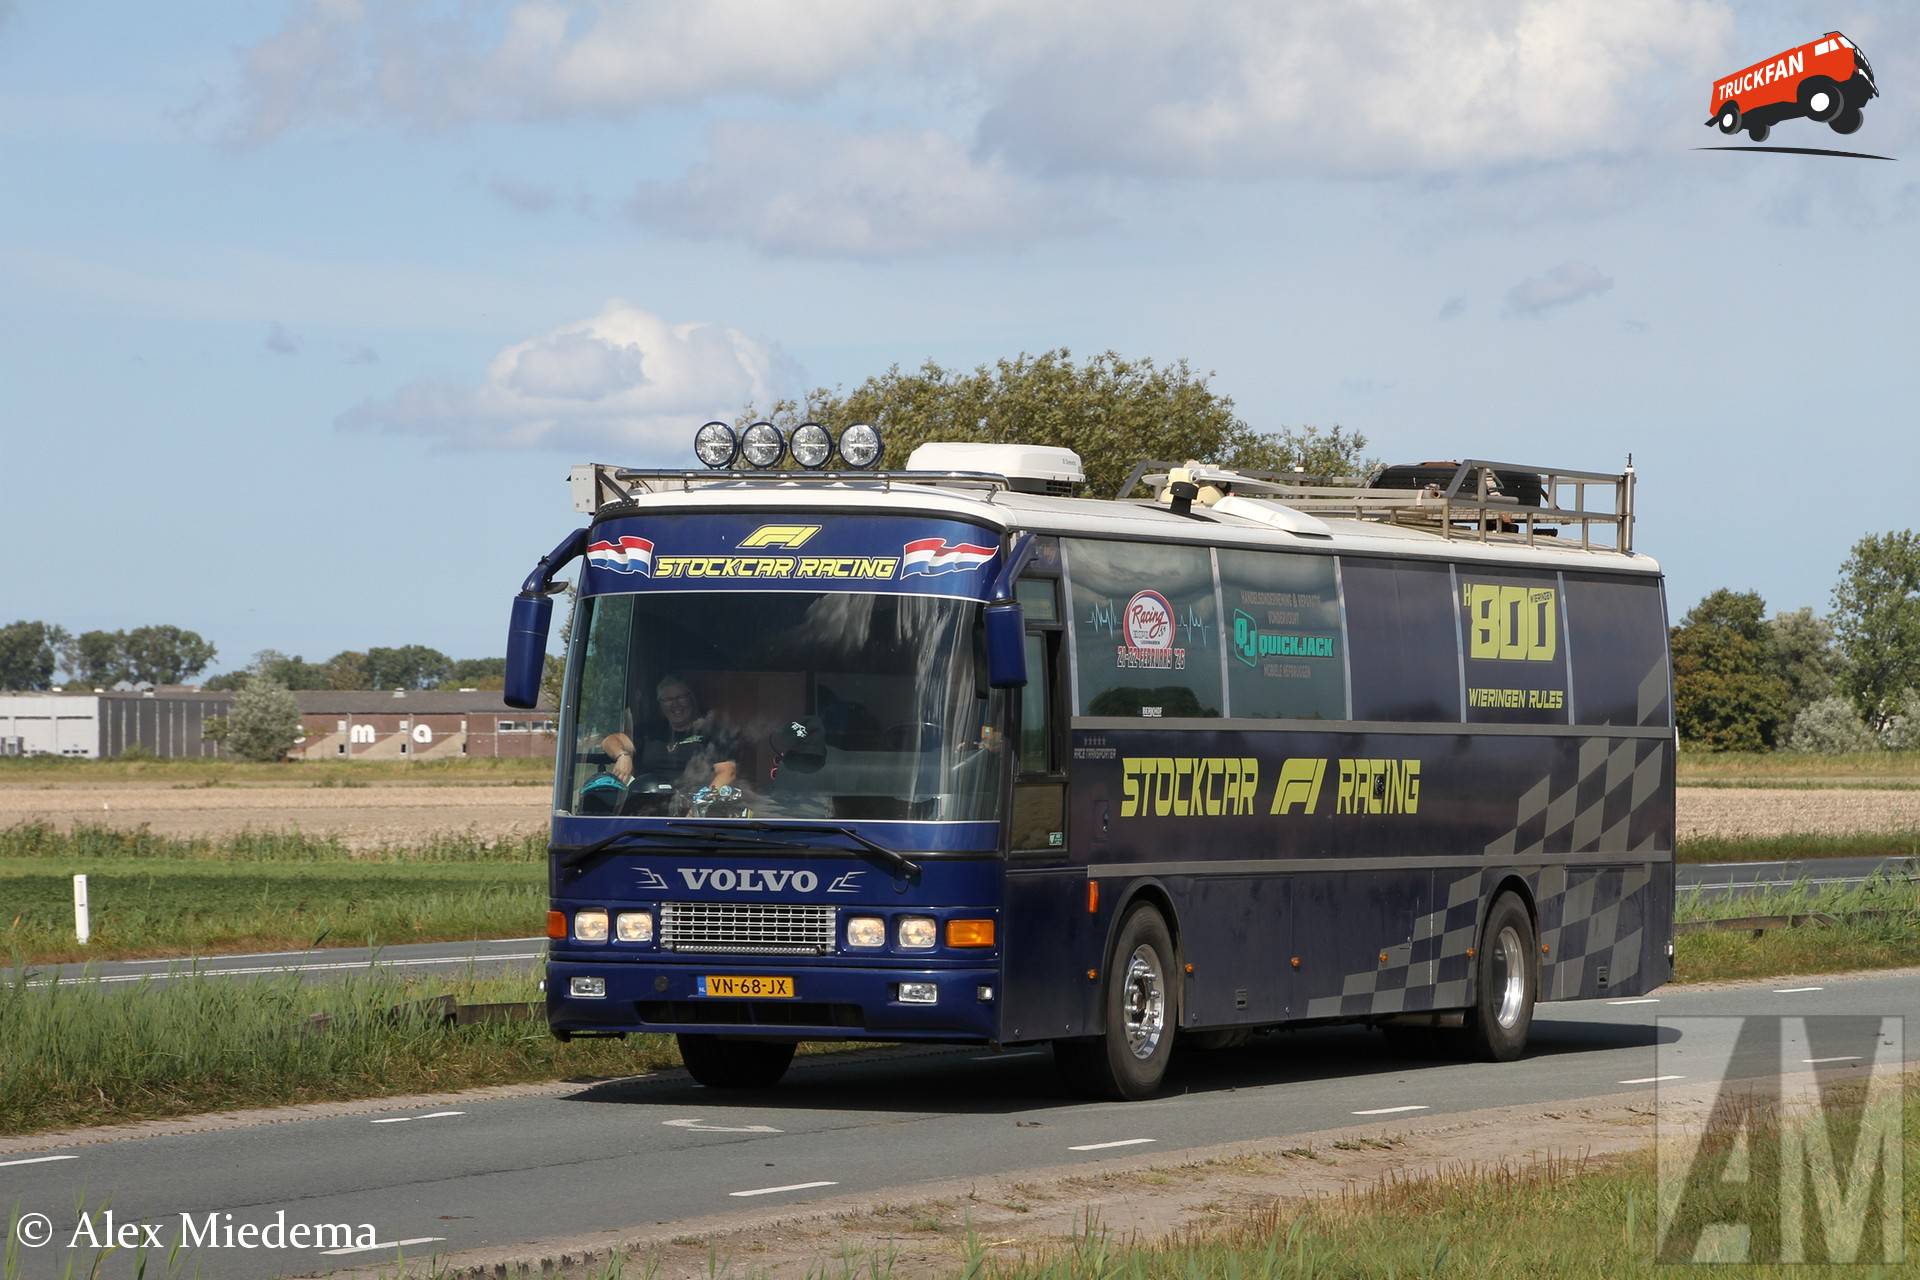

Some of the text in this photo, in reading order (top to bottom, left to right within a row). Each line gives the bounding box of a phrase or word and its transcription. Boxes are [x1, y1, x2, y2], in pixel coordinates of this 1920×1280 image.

[654, 557, 898, 578] STOCKCAR RACING
[1259, 635, 1333, 656] QUICKJACK
[1469, 688, 1563, 709] WIERINGEN RULES
[1120, 757, 1259, 817] STOCKCAR
[1336, 758, 1421, 814] RACING
[677, 868, 818, 893] VOLVO
[711, 978, 787, 995] VN-68-JX
